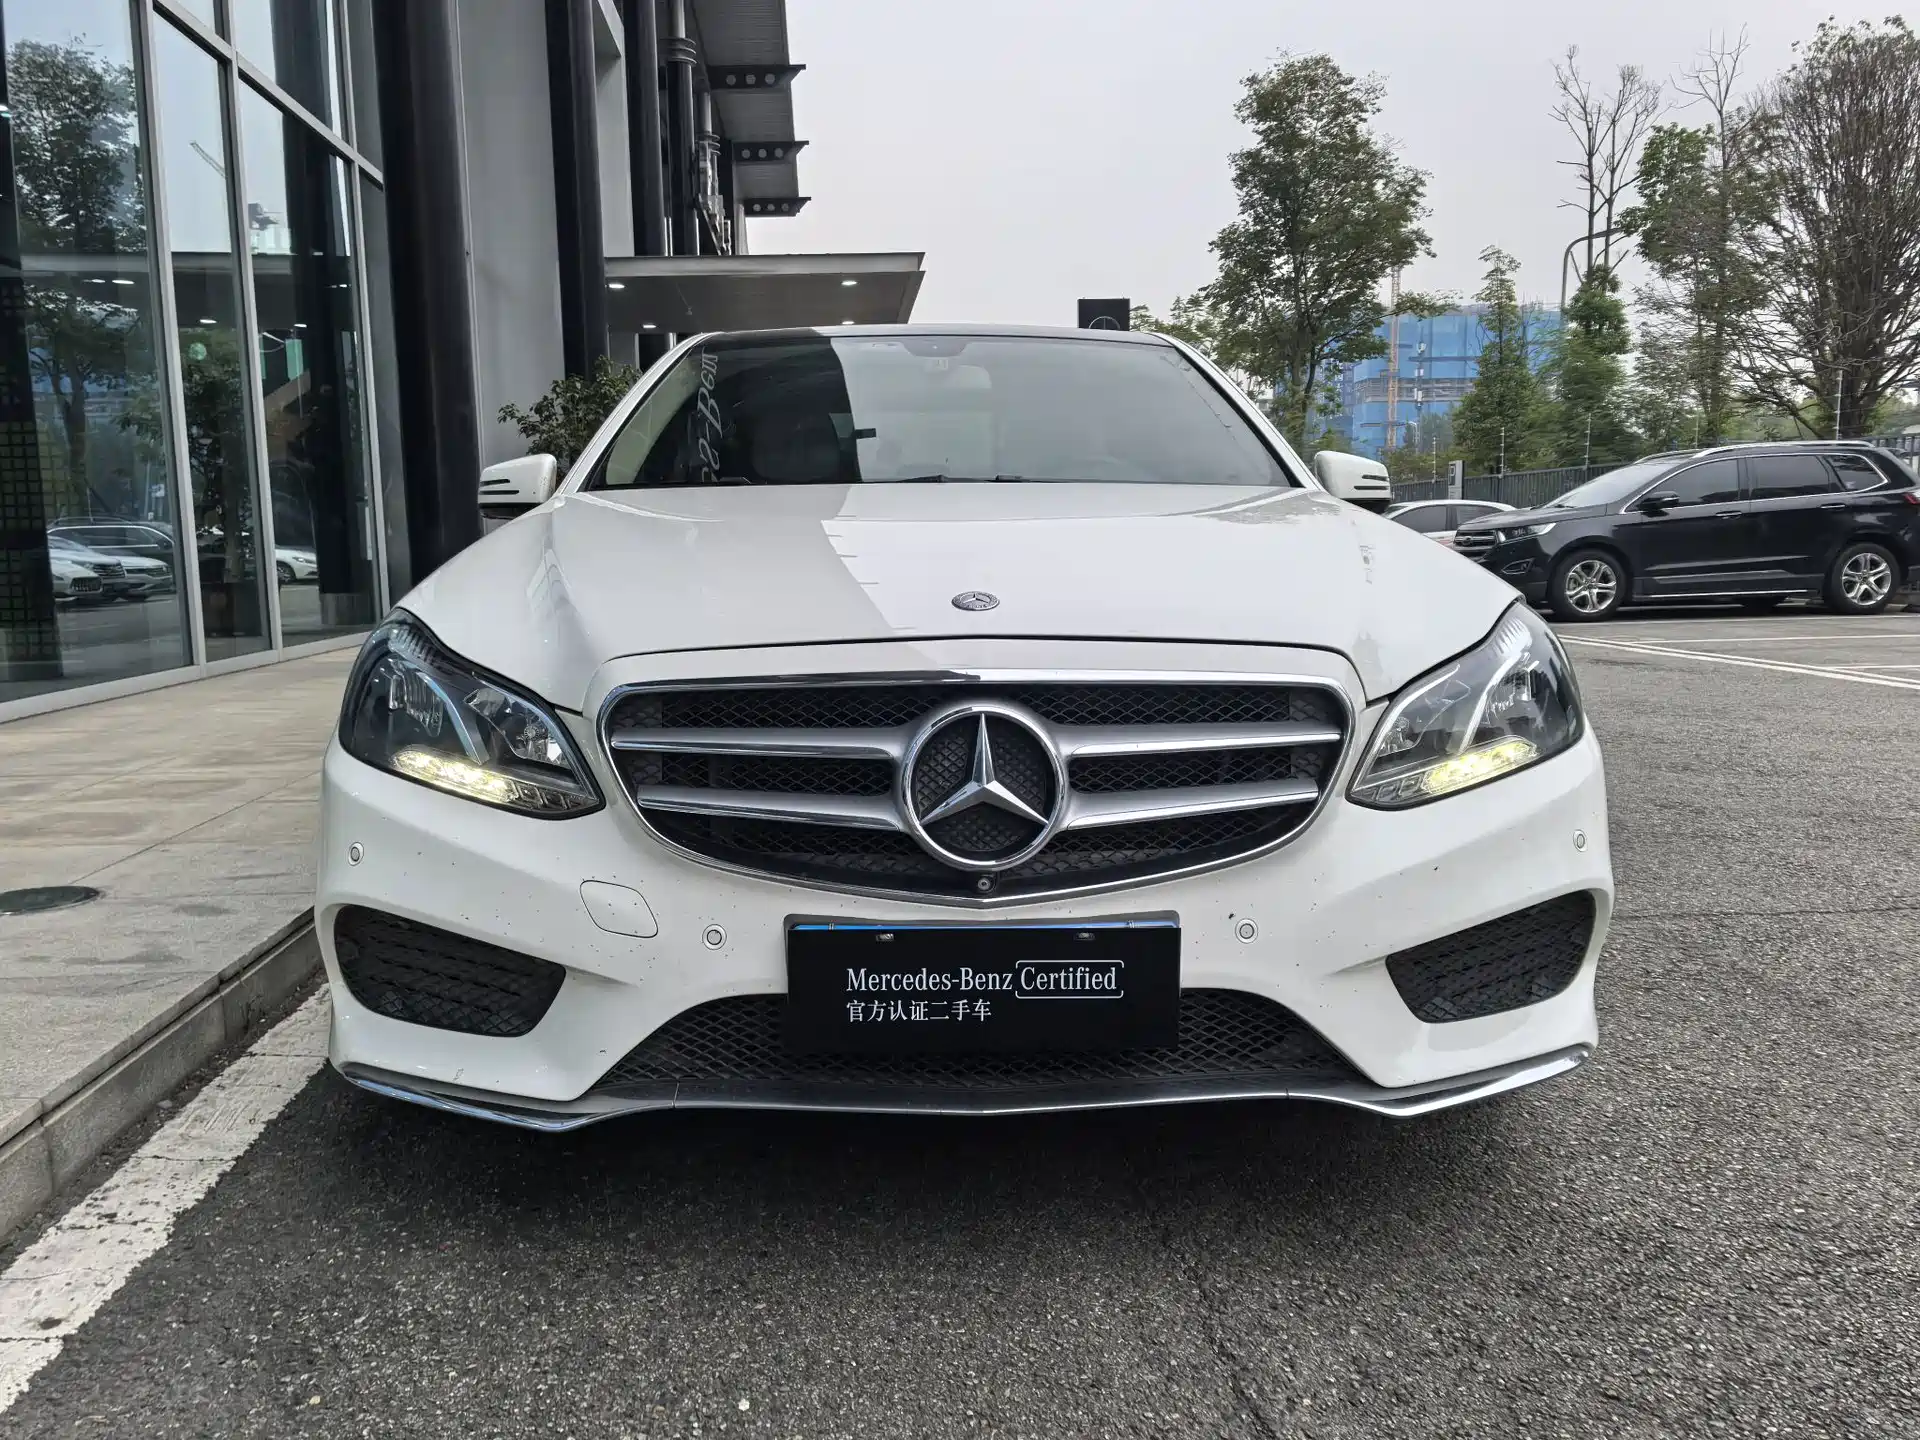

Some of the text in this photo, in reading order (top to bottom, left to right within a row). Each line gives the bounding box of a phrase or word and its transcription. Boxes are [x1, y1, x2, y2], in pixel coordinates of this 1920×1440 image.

[846, 966, 1117, 992] Mercedes-Benz Certified
[846, 998, 992, 1022] 官方认证二手车
